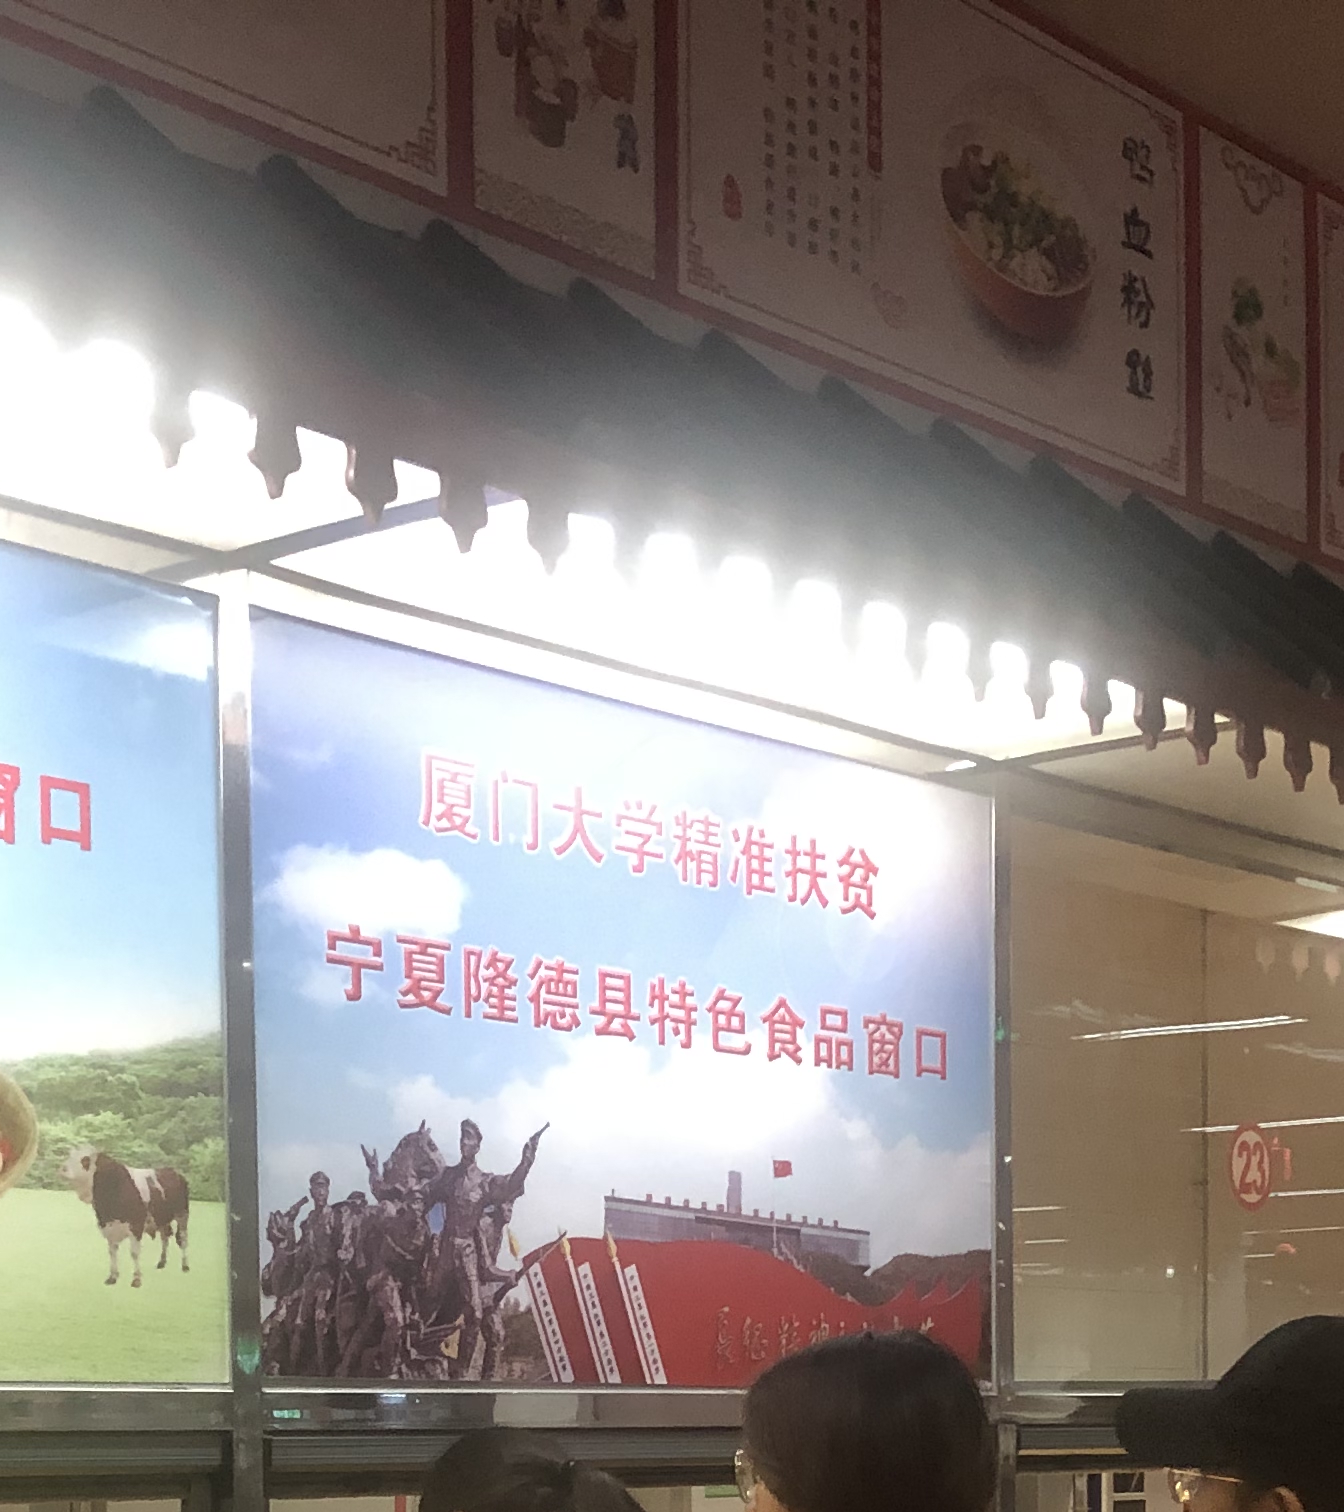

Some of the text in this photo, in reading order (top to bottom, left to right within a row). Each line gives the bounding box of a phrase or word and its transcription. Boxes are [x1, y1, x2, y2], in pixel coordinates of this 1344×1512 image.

[418, 751, 881, 922] 厦门大学精准扶贫
[323, 921, 950, 1082] 宁夏隆德县特色食品窗口
[1237, 1140, 1267, 1196] 23
